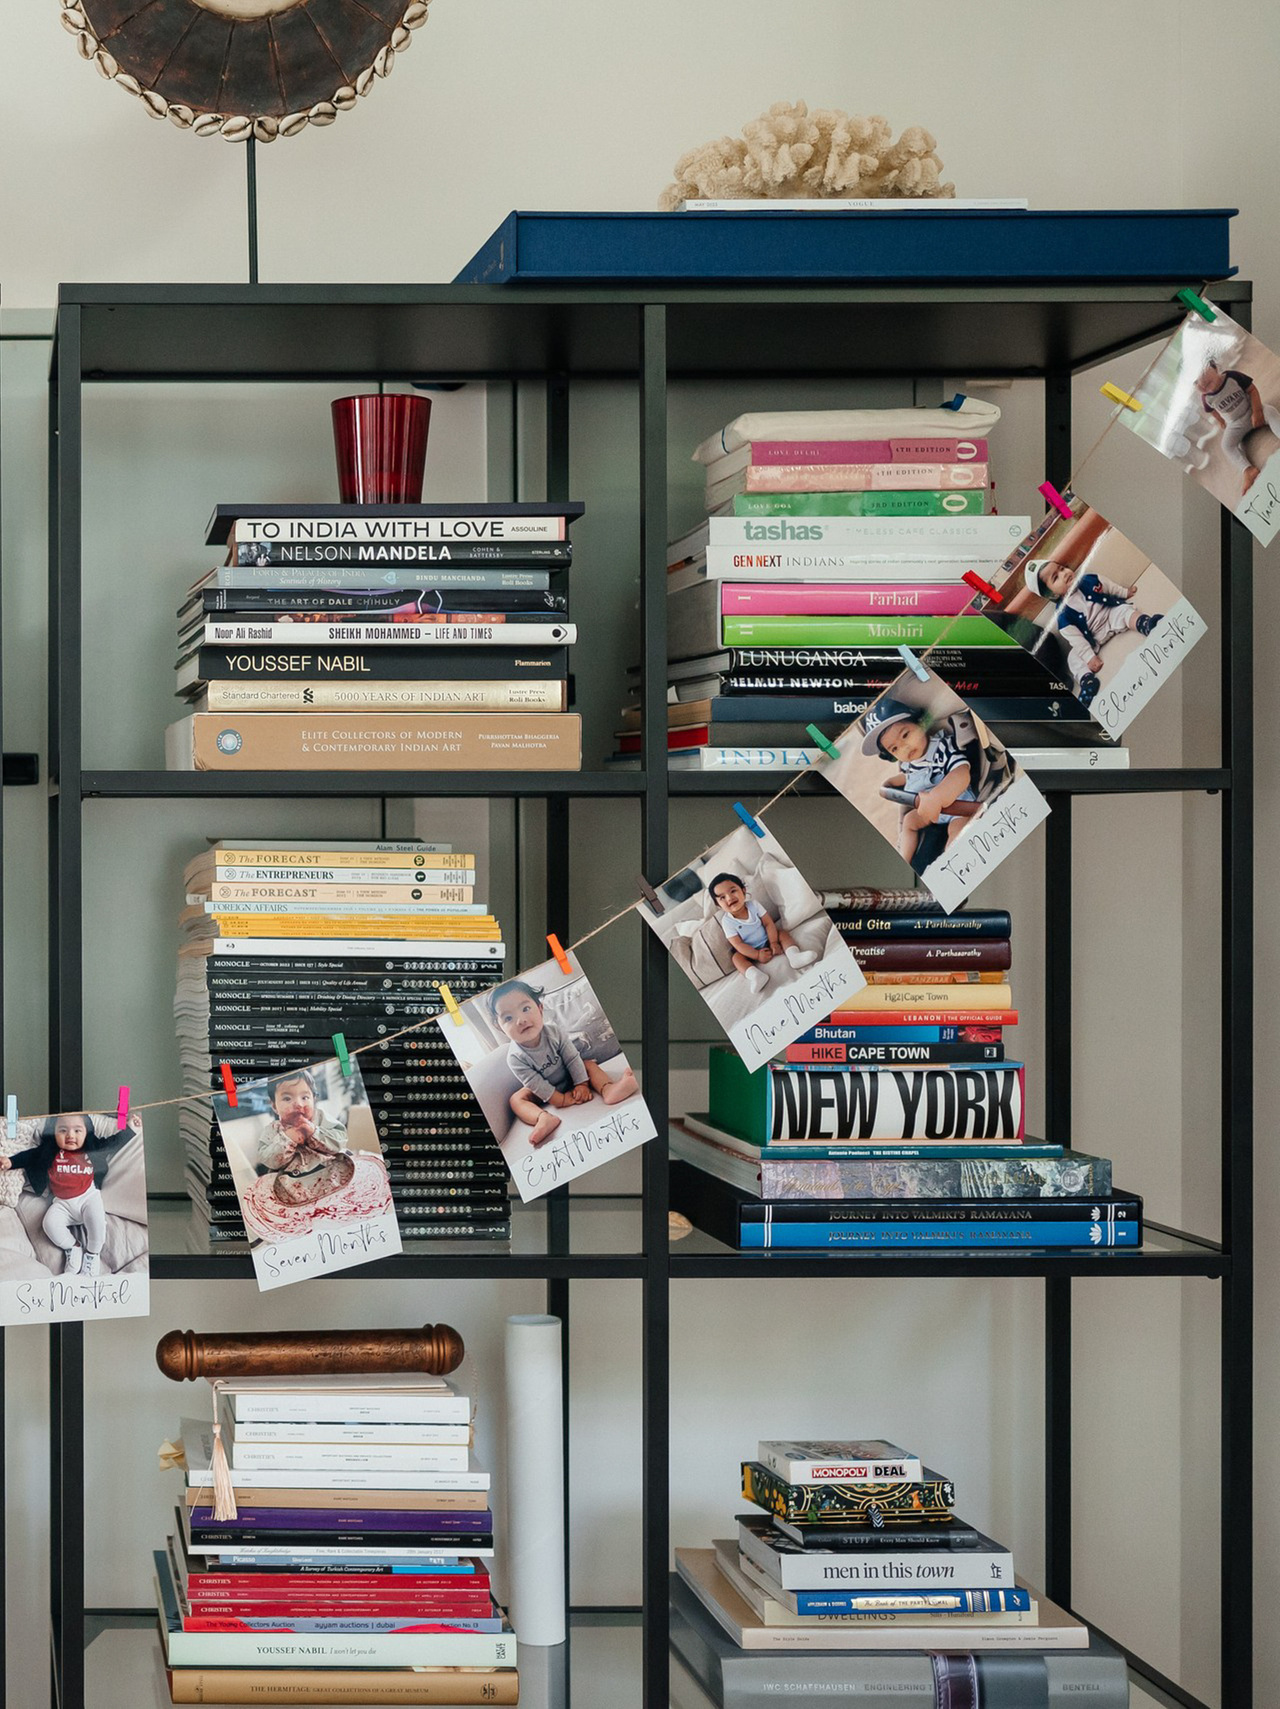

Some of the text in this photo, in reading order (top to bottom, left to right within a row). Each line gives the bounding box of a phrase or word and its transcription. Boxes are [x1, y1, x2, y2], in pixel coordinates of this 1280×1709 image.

[1244, 482, 1280, 525] Twel
[248, 522, 280, 538] TO
[290, 522, 357, 538] INDIA
[366, 521, 429, 537] WITH
[440, 521, 504, 537] LOVE
[744, 520, 823, 540] tashas
[281, 546, 451, 561] NELSON MANDELA
[734, 555, 845, 567] GEN NEXT INDIANS
[870, 592, 918, 606] Farhad
[215, 627, 493, 640] Noor Ali Rashid SHEIKH MOHAMMED LIFE AND TIMES
[868, 624, 923, 637] Moshiri
[226, 655, 370, 671] YOUSSEF NABIL
[739, 651, 866, 667] LUNUGANGA
[1098, 612, 1195, 729] Eleven Months
[790, 679, 854, 688] NEWTON
[223, 691, 486, 702] Standard Chartered 5000 YEARS OF INDIAN ART
[721, 751, 811, 765] INDIA
[940, 803, 1028, 885] Ten Months
[239, 855, 320, 864] The FORECAST
[240, 870, 334, 880] The ENTREPRENEURS
[213, 903, 287, 912] FOREIGN AFFAIRS
[867, 920, 891, 930] Gita
[745, 969, 848, 1054] Nine Months
[815, 1028, 855, 1038] Bhutan
[812, 1047, 929, 1059] HIKE CAPE TOWN
[772, 1071, 1016, 1139] NEW YORK
[522, 1113, 640, 1187] Eight Months
[829, 1210, 1032, 1221] JOURNEY INTO VALMIKI'S RAMAYANA
[261, 1224, 388, 1279] Seven Months
[16, 1283, 45, 1314] Six
[813, 1465, 905, 1477] MONOPOLY DEAL
[824, 1562, 954, 1578] men in this town
